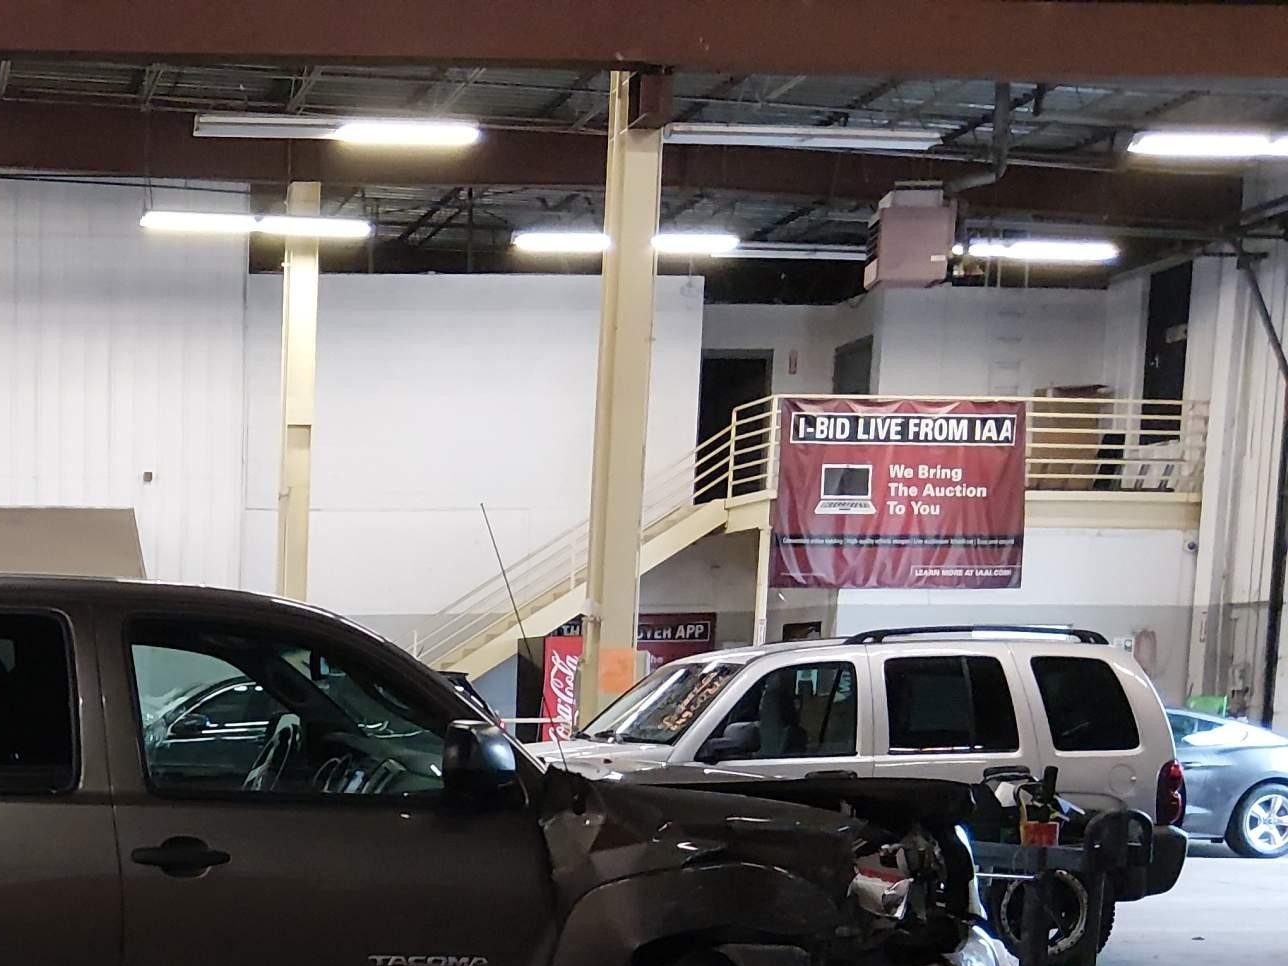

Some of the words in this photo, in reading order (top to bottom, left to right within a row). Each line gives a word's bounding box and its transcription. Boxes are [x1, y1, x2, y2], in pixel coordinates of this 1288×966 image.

[799, 417, 849, 439] I-BID
[857, 417, 902, 440] LIVE
[908, 418, 968, 441] FROM
[974, 418, 1012, 441] IAA
[889, 465, 913, 479] We
[918, 464, 962, 481] Bring
[888, 482, 917, 497] The
[922, 483, 987, 498] Auction
[887, 501, 905, 515] To
[911, 501, 940, 516] You
[675, 624, 704, 639] APP
